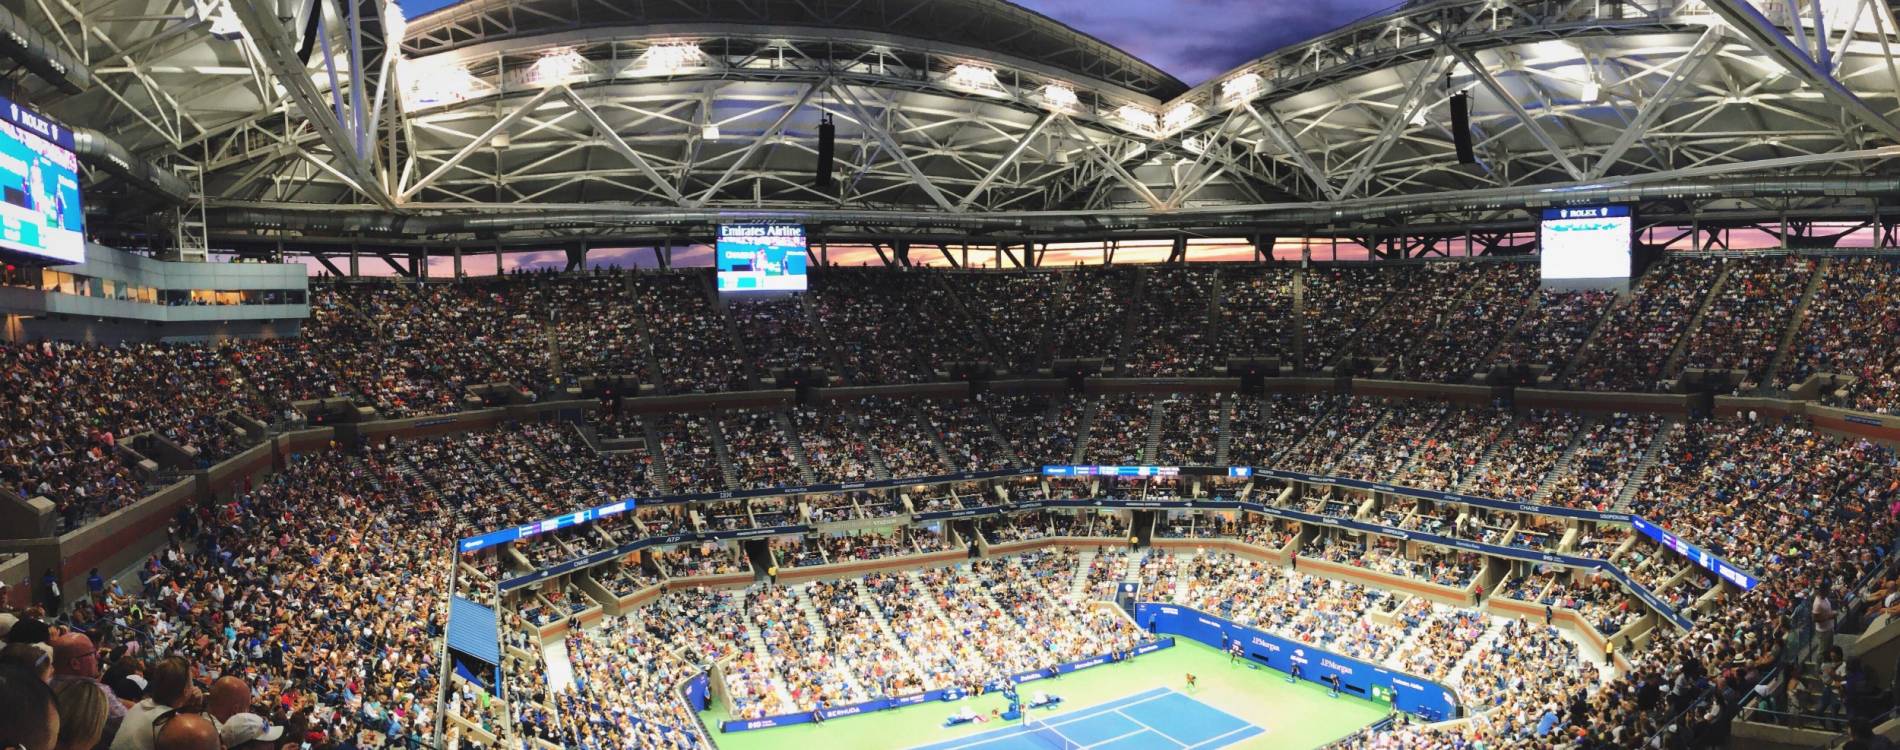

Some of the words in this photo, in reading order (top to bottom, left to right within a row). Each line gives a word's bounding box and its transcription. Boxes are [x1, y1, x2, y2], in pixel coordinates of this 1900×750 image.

[21, 110, 49, 136] ROLEX
[1569, 209, 1598, 217] ROLEX
[721, 225, 765, 236] Emirates
[767, 225, 801, 236] Airline
[1519, 504, 1540, 512] CHASE
[827, 707, 860, 718] BERMUDA
